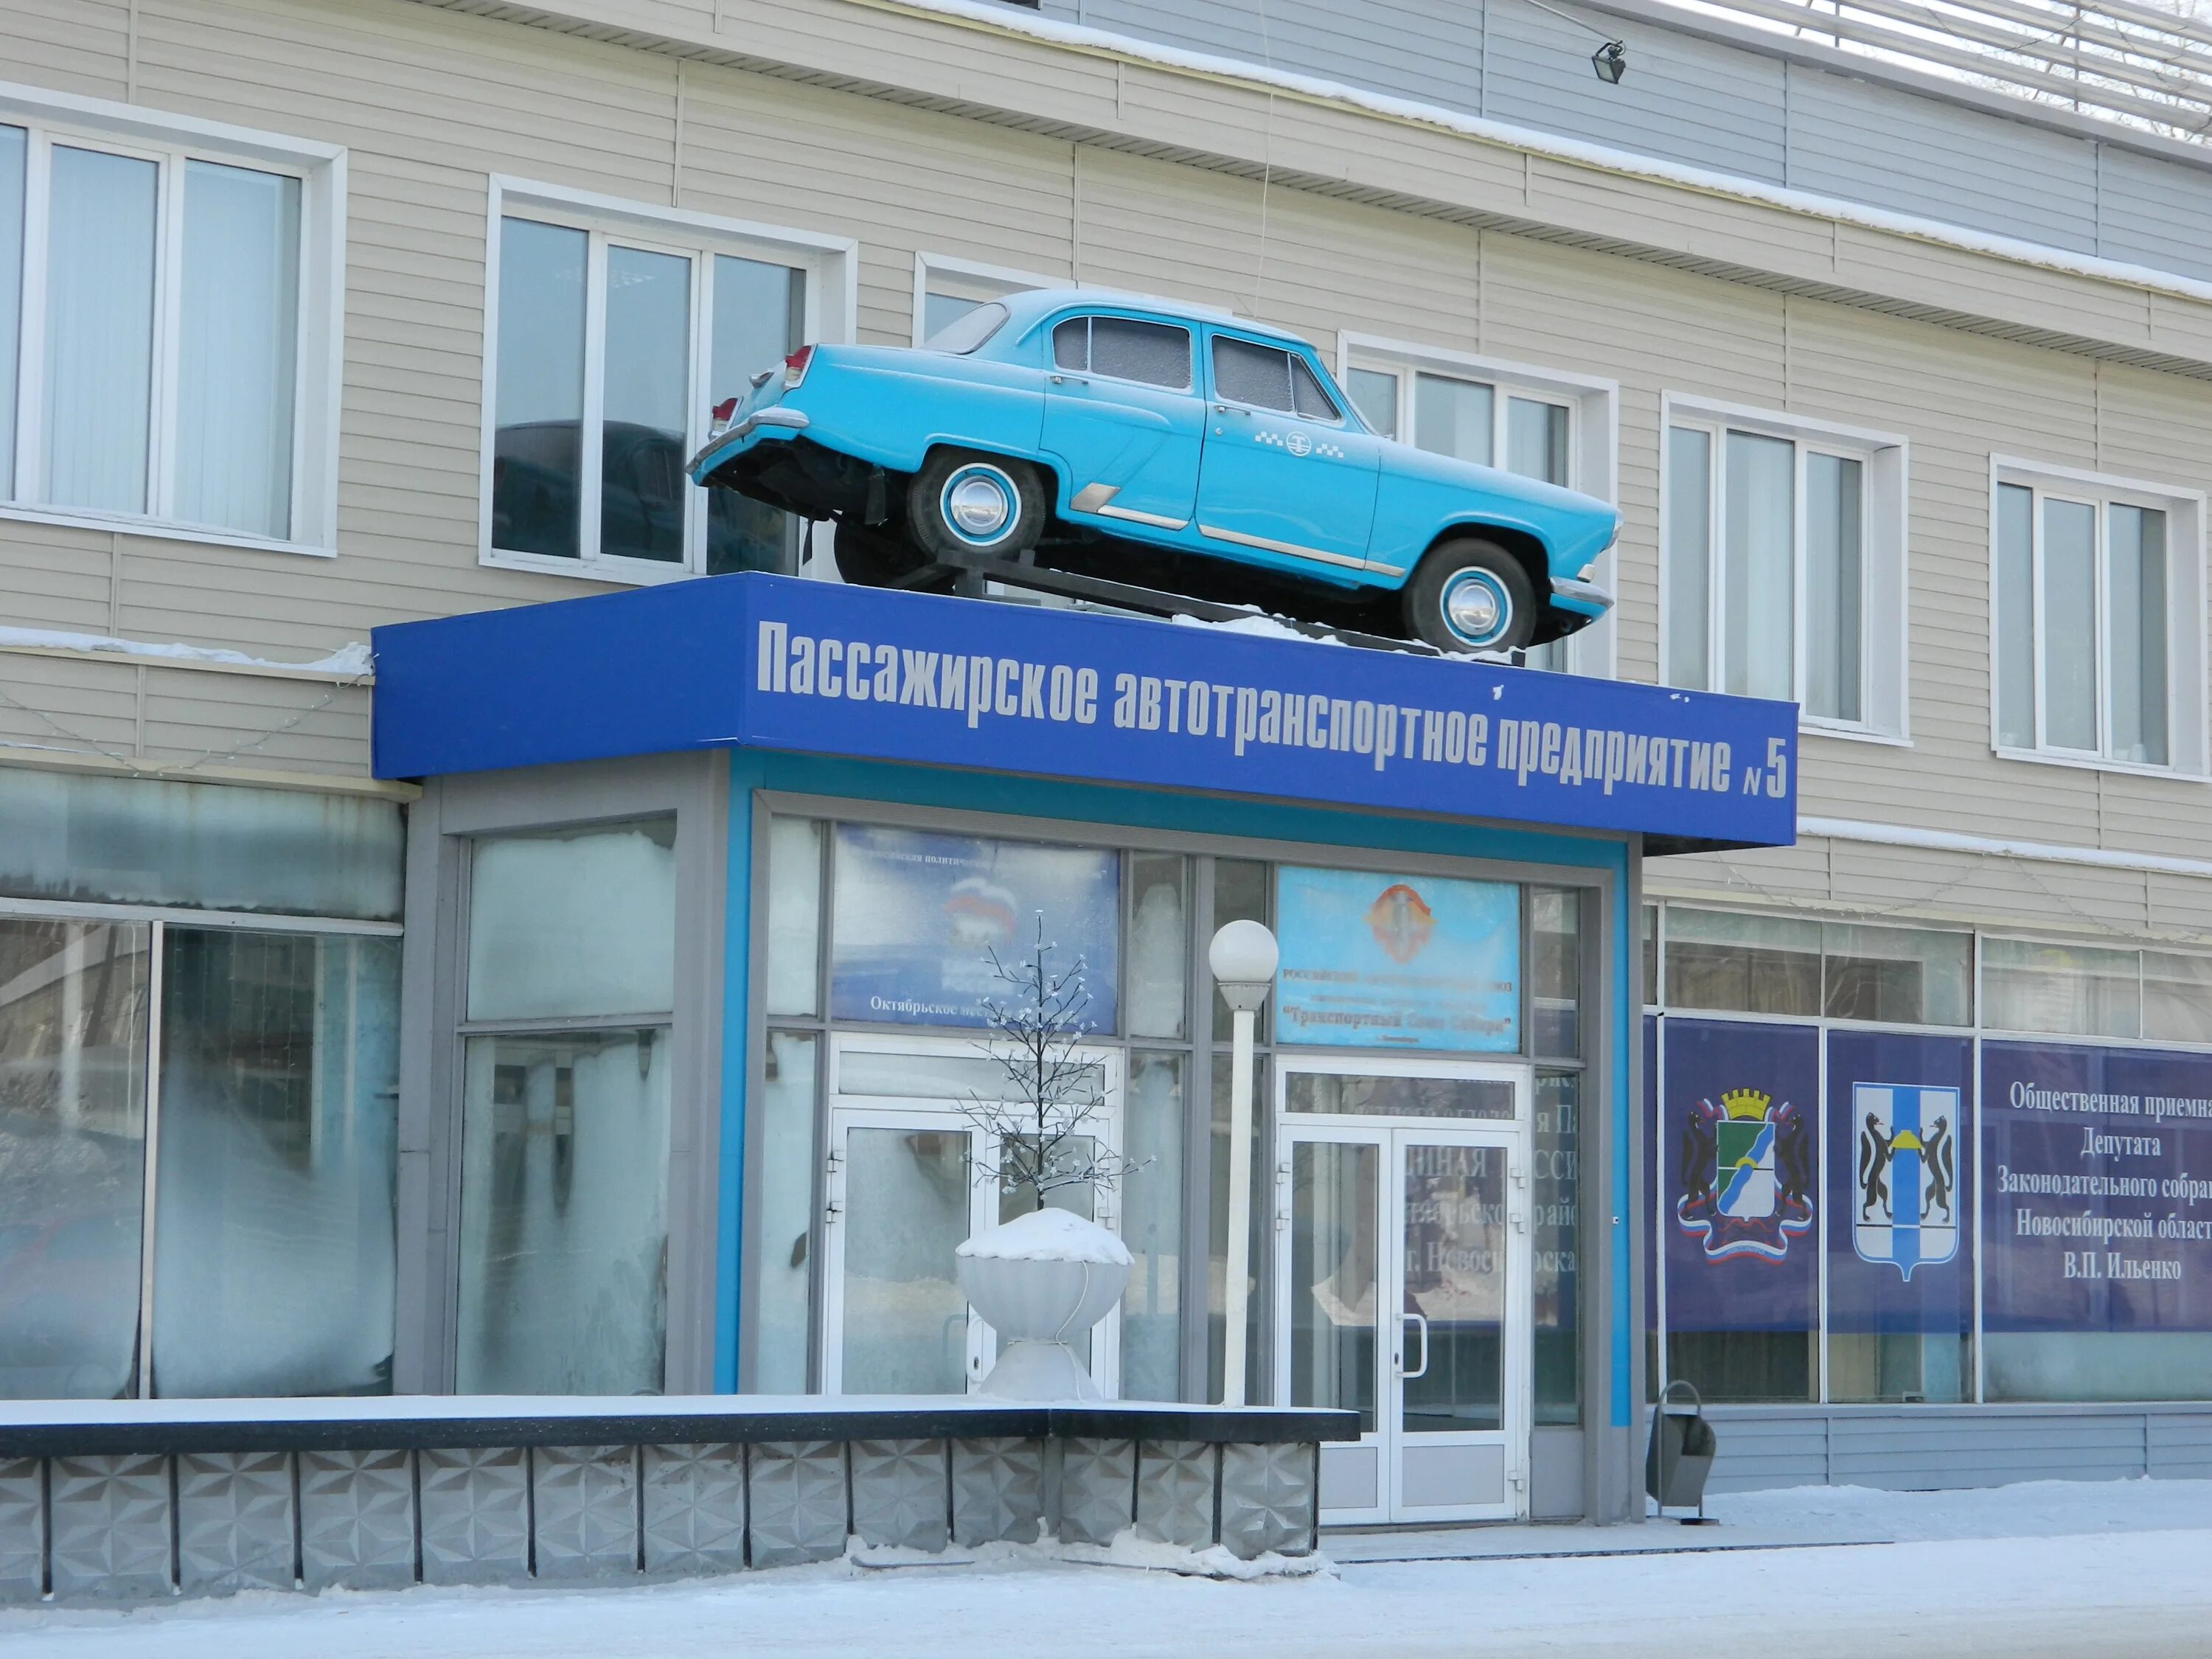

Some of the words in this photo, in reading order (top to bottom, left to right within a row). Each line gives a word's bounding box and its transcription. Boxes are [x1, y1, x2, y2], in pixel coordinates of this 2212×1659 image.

[757, 620, 1098, 728] Пассажирское
[1113, 673, 1488, 771] автотранспортное
[1498, 719, 1731, 796] предприятие
[870, 995, 958, 1016] Октябрьское
[2009, 1081, 2140, 1115] Общественная
[2079, 1127, 2161, 1162] Депутата
[1997, 1164, 2157, 1198] Законодательного
[2015, 1208, 2154, 1245] Новосибирской
[2063, 1251, 2101, 1278] В.П.
[2106, 1251, 2182, 1279] Ильенко
